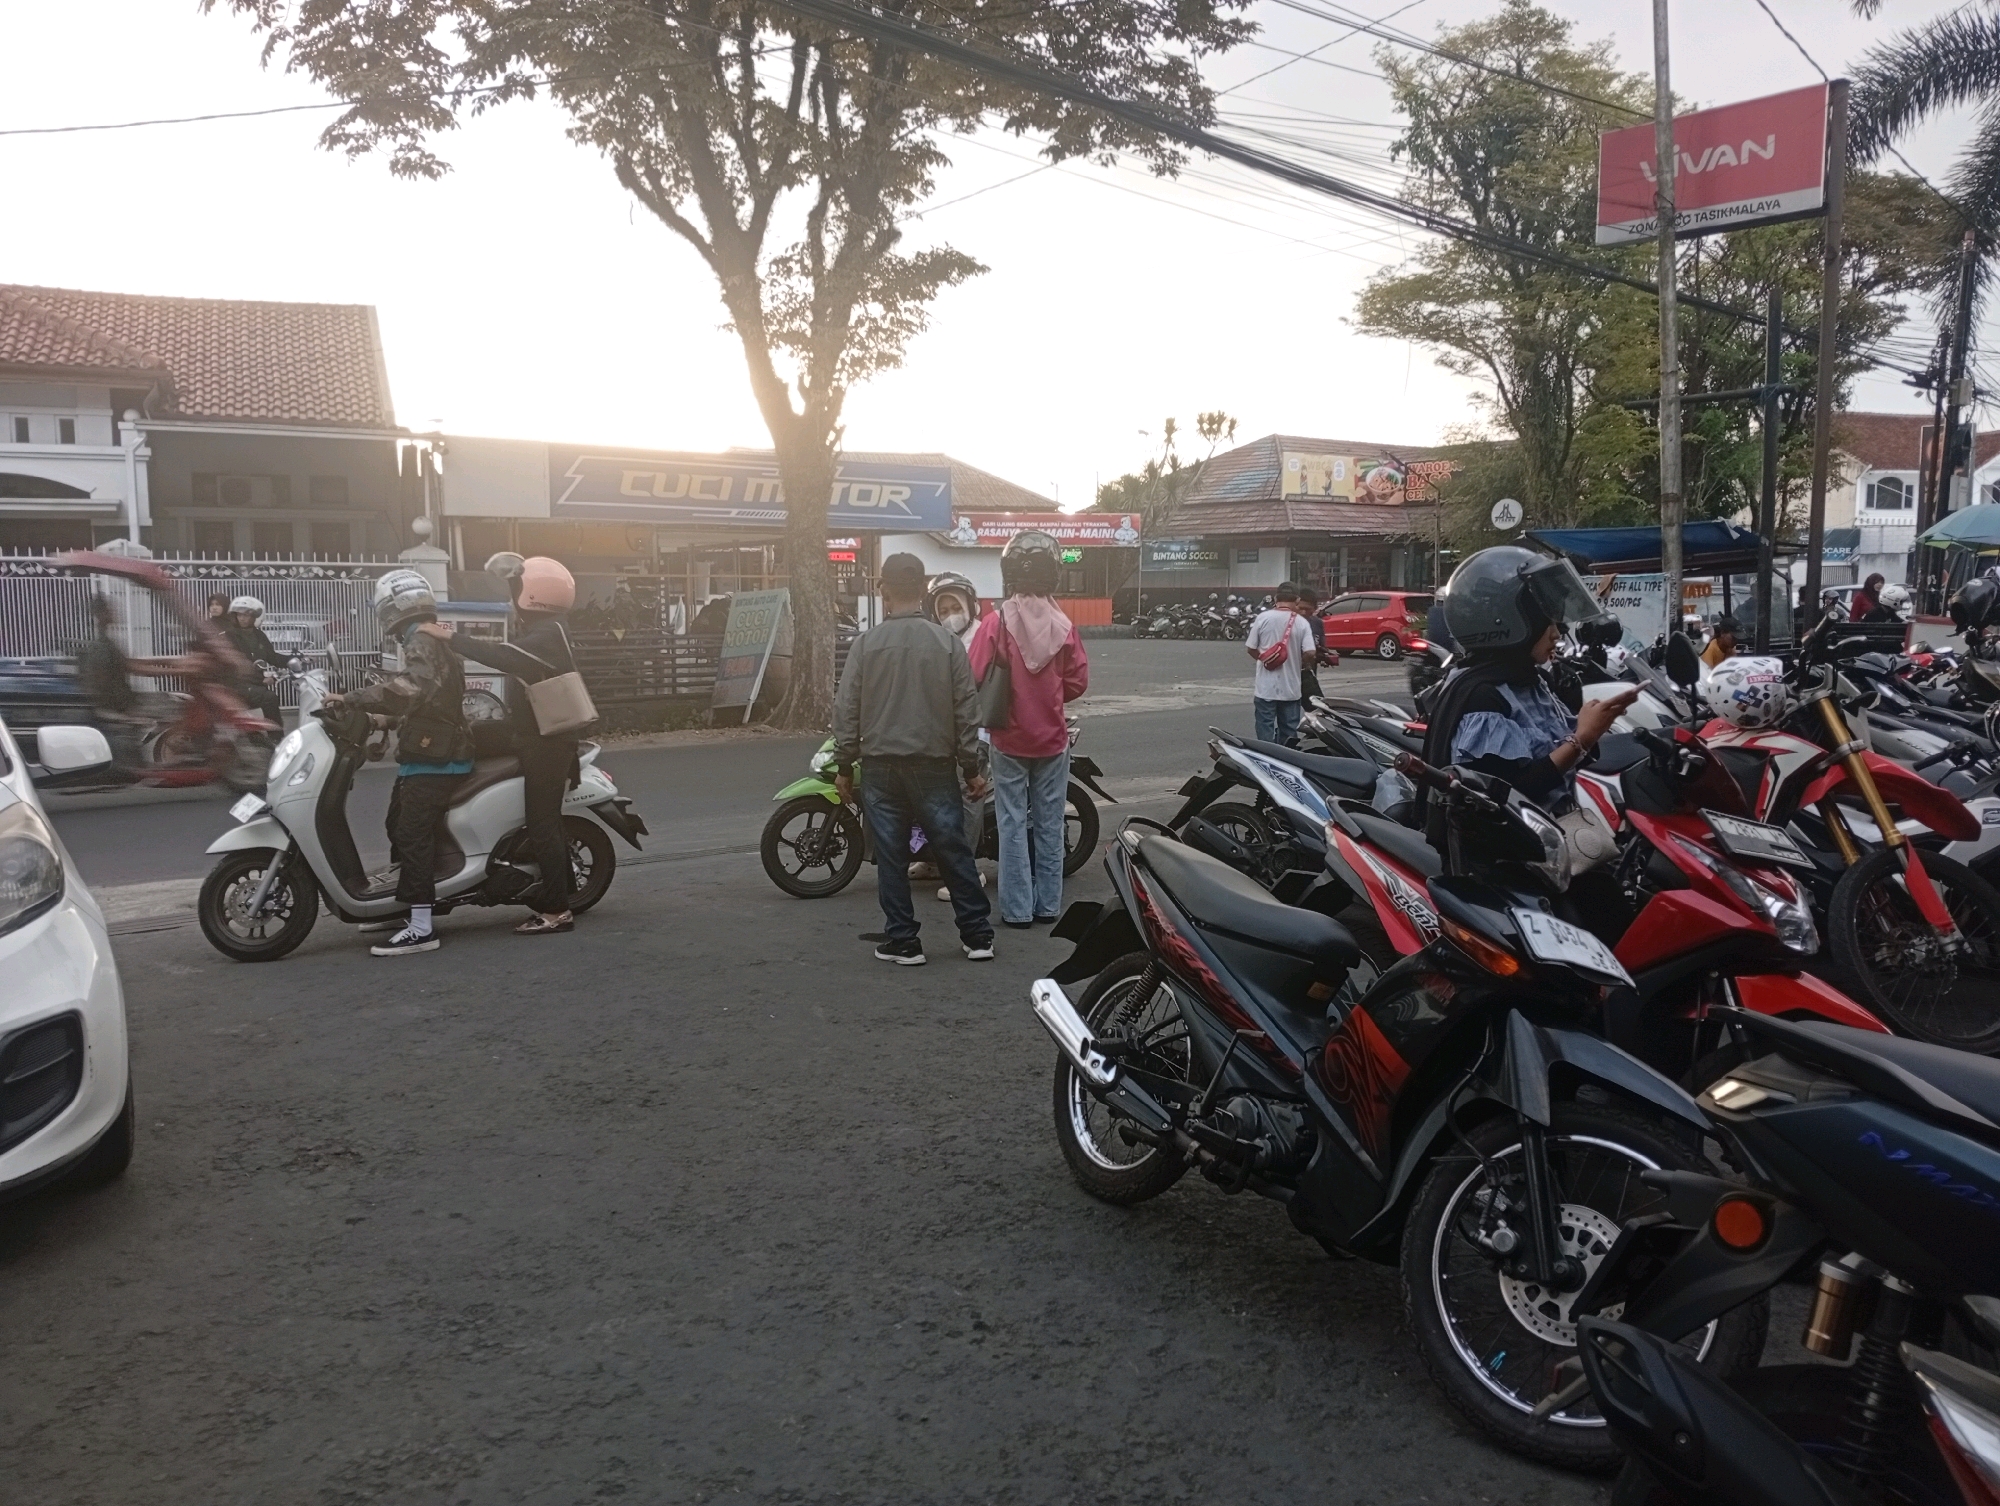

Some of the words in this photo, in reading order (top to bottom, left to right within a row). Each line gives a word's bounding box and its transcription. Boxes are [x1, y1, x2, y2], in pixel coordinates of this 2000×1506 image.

[1694, 198, 1781, 223] TASIKMALAYA
[619, 469, 734, 502] CUCI
[741, 475, 913, 516] MTOR
[1152, 551, 1188, 561] BINTANG
[1188, 551, 1219, 561] SOCCER
[1628, 581, 1641, 591] ALL
[1644, 580, 1663, 591] TYPE
[1603, 597, 1642, 608] 9.500/PCS
[735, 609, 771, 628] CUCI
[725, 627, 770, 648] MOTOR
[1482, 629, 1511, 642] JPN
[1523, 913, 1542, 935] Z
